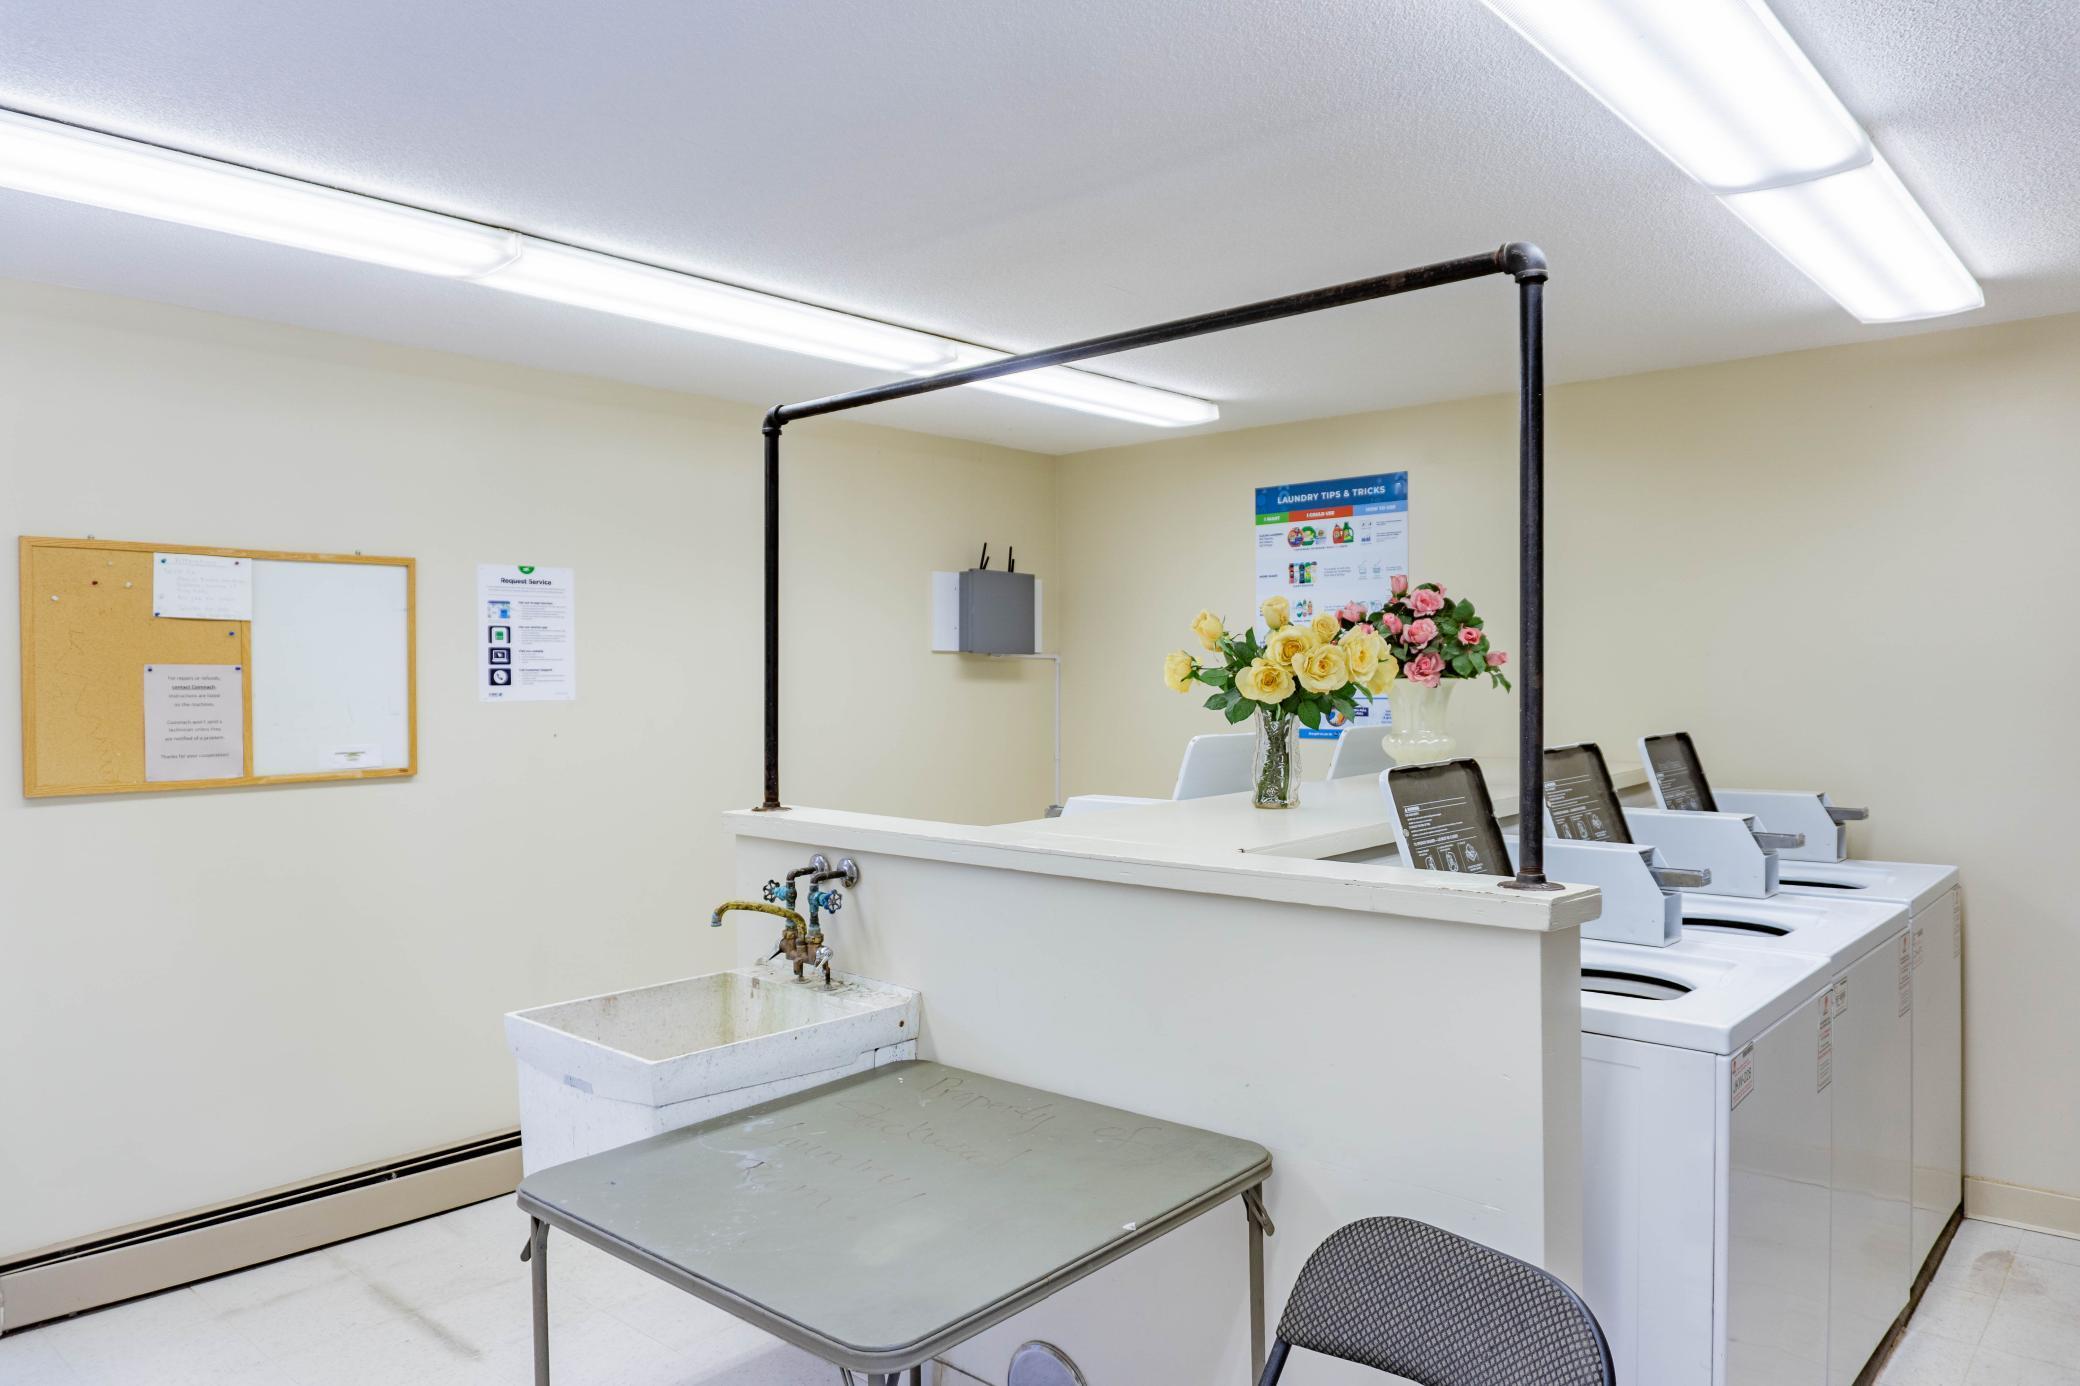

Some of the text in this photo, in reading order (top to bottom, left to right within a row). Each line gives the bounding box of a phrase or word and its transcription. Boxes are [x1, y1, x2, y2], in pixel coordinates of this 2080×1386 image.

[1277, 485, 1386, 504] LAUNDRY TIPS & TRICKS
